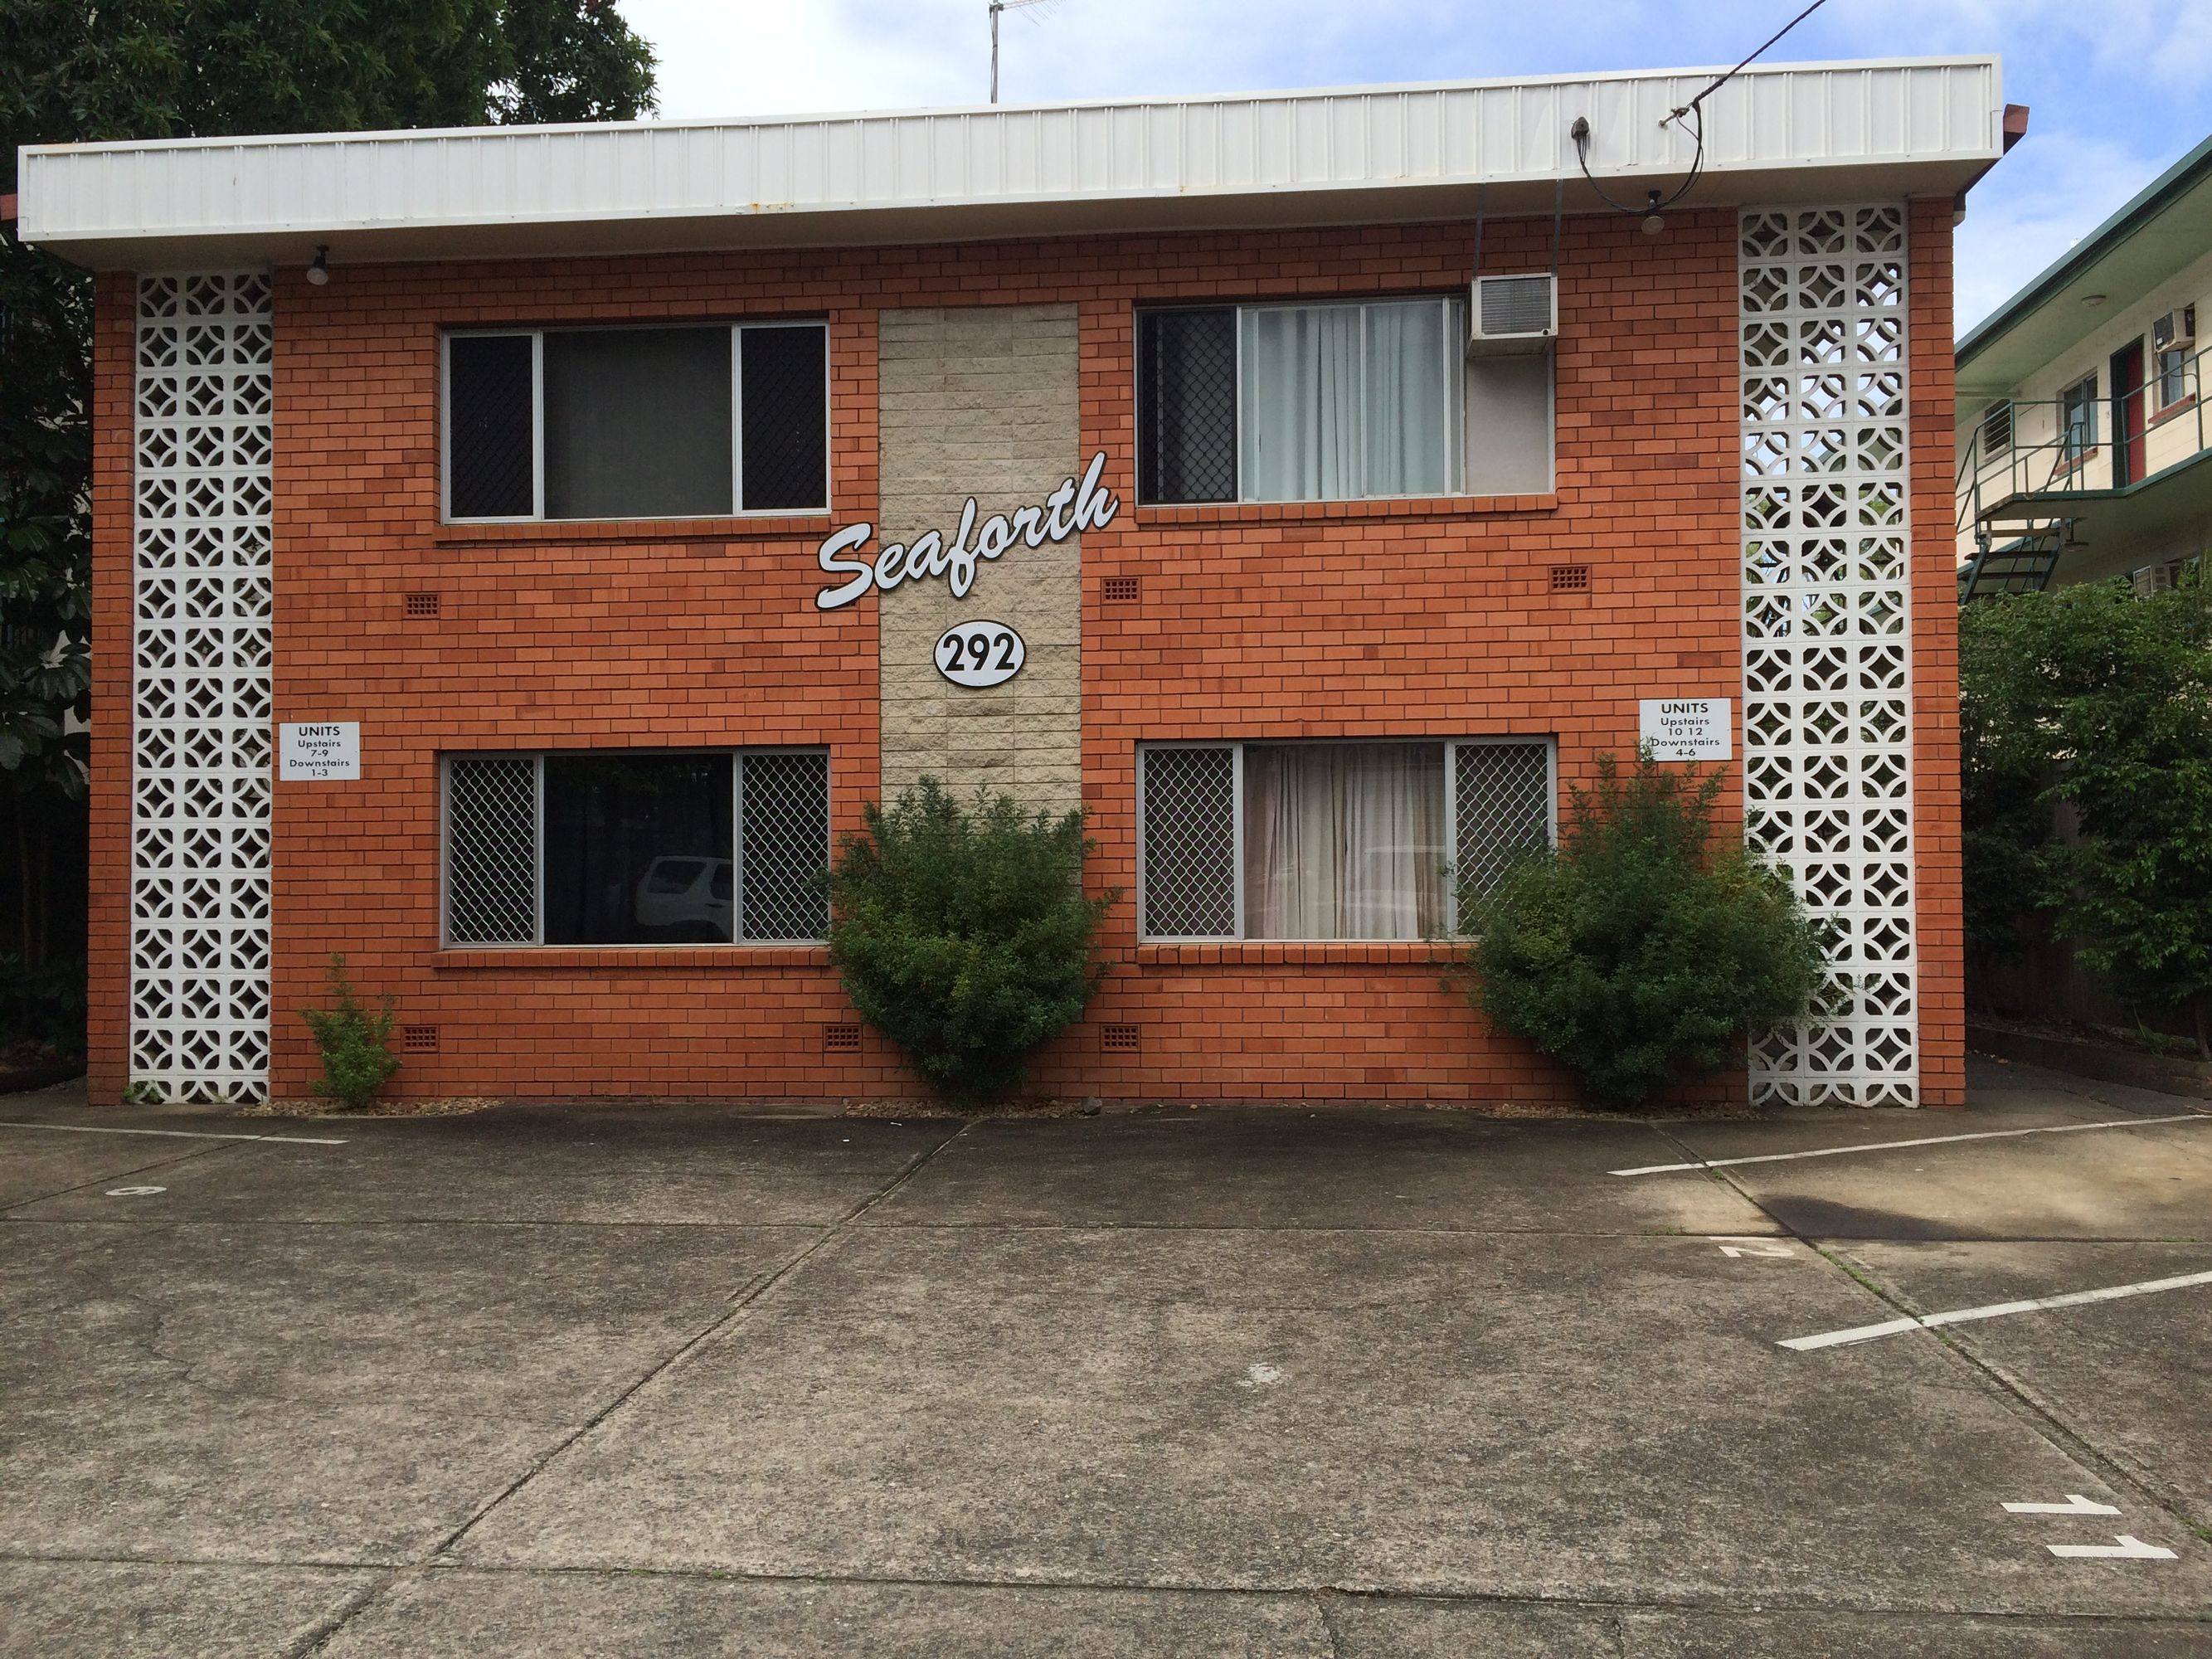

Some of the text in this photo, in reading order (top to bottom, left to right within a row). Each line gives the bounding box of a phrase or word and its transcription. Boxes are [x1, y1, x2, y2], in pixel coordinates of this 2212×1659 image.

[815, 450, 1120, 610] Seaforth
[943, 633, 1015, 671] 292
[1661, 703, 1709, 713] UNITS
[1660, 717, 1709, 727] Upstairs
[299, 726, 340, 736] UNITS
[1669, 727, 1703, 736] 10 12
[298, 739, 341, 749] Upstairs
[1651, 737, 1720, 747] Downstairs
[289, 759, 350, 767] Downstairs
